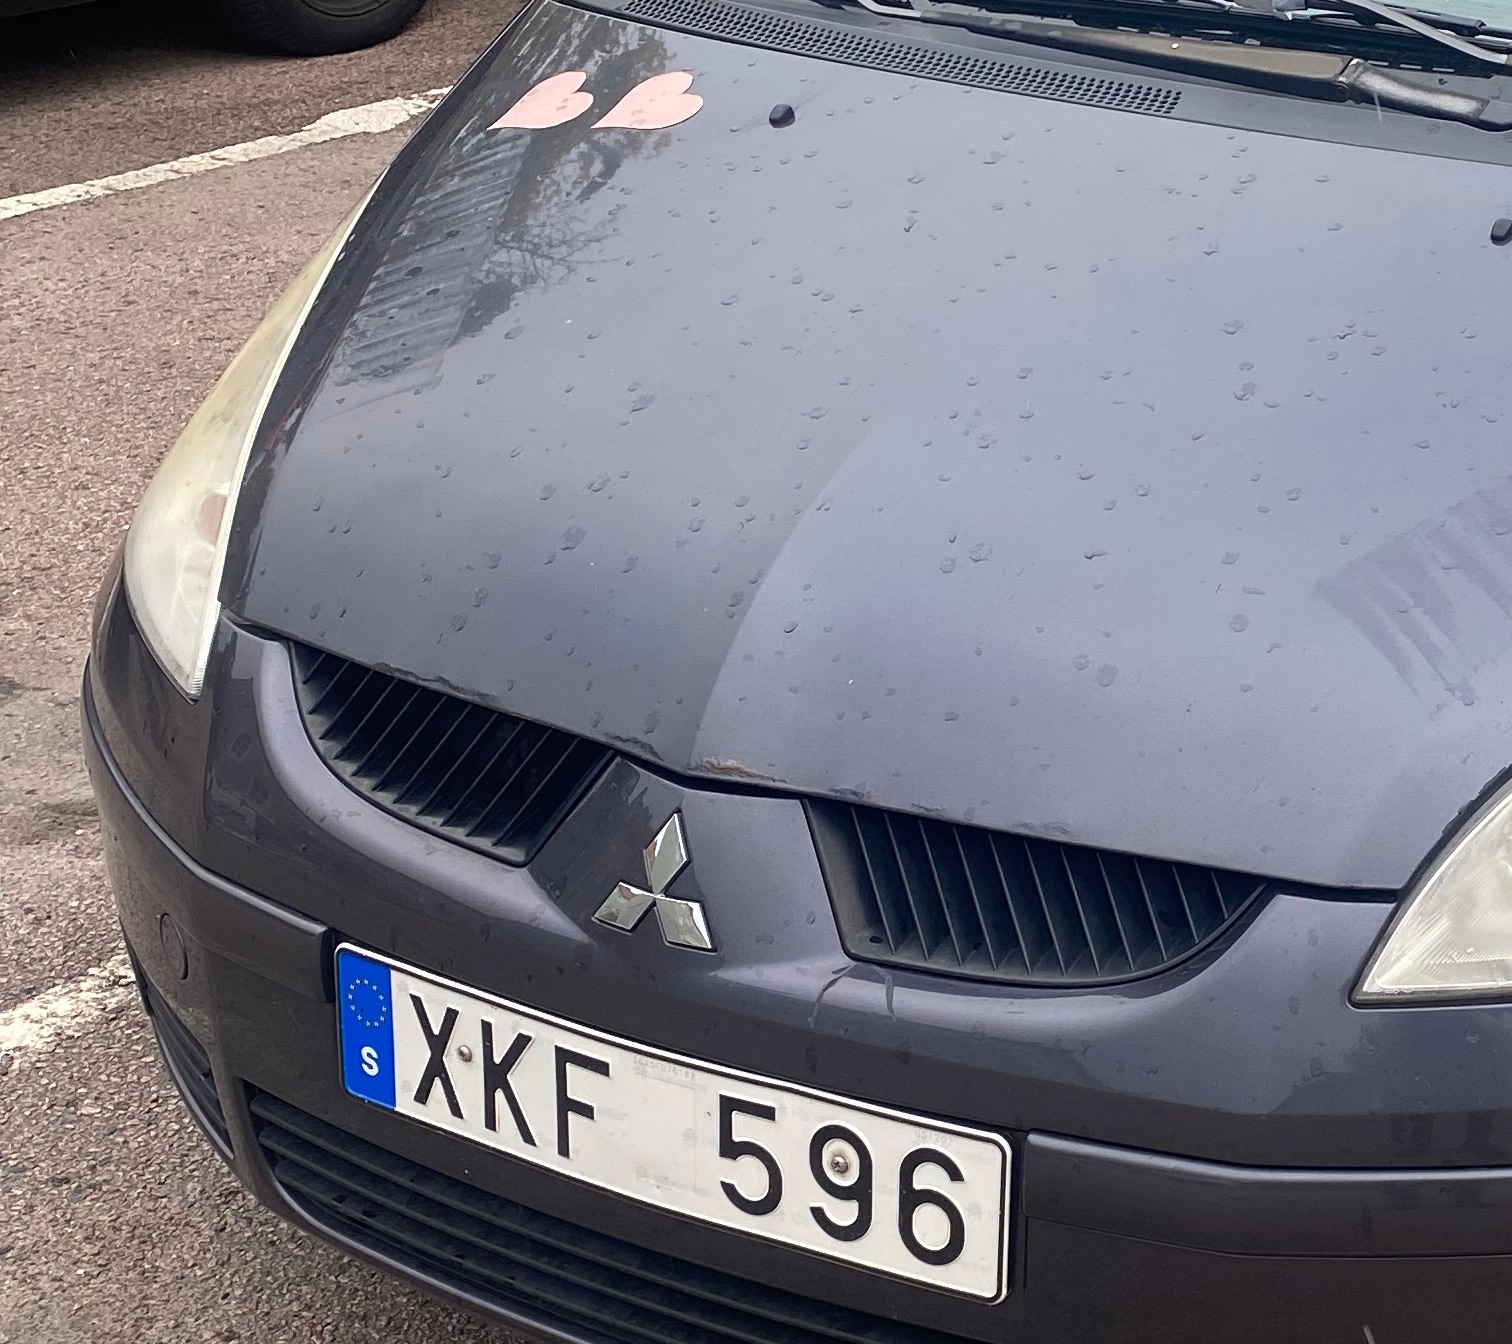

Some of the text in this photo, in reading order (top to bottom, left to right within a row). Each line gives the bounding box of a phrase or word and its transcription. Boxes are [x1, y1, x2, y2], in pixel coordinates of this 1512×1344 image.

[361, 1046, 379, 1076] S
[409, 992, 965, 1266] XKF 596
